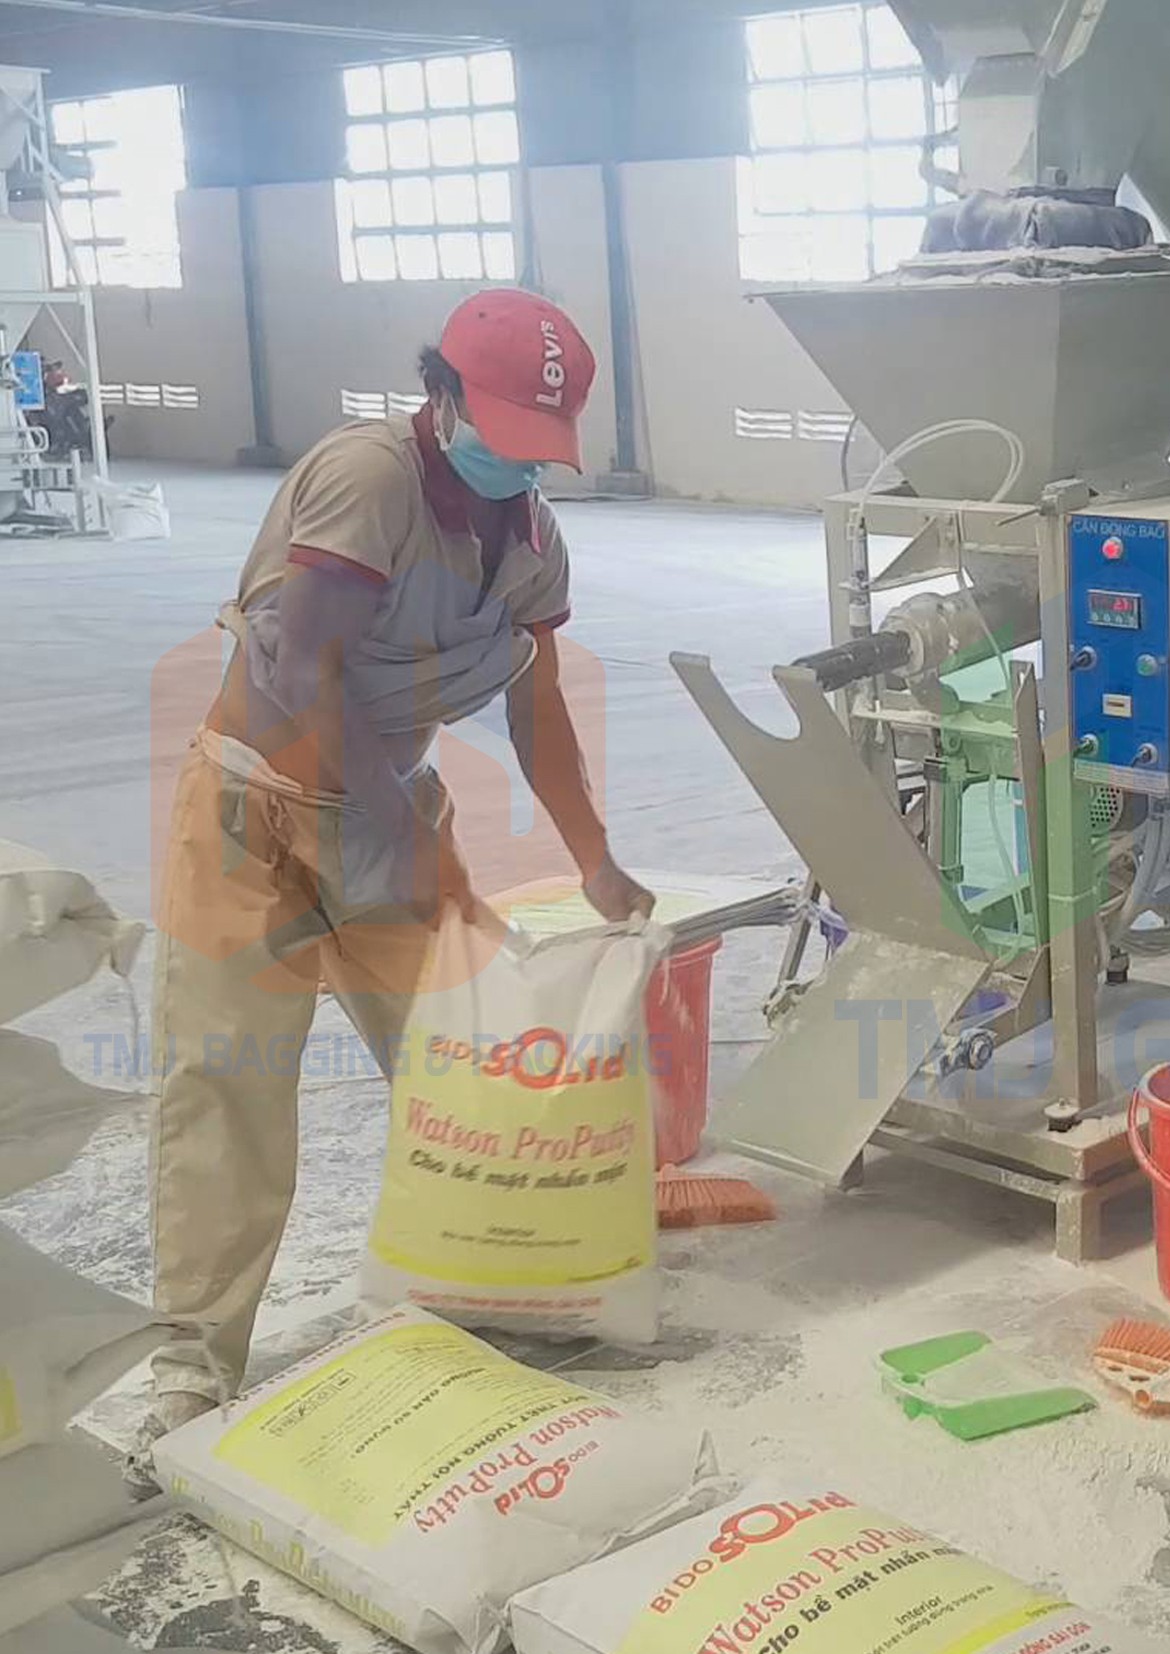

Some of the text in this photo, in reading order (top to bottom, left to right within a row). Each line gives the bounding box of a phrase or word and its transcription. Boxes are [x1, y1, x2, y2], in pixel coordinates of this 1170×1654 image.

[412, 1441, 539, 1534] ProPutty
[649, 1558, 714, 1615] BIDO
[696, 1569, 822, 1654] Watson
[894, 1595, 944, 1637] Interior
